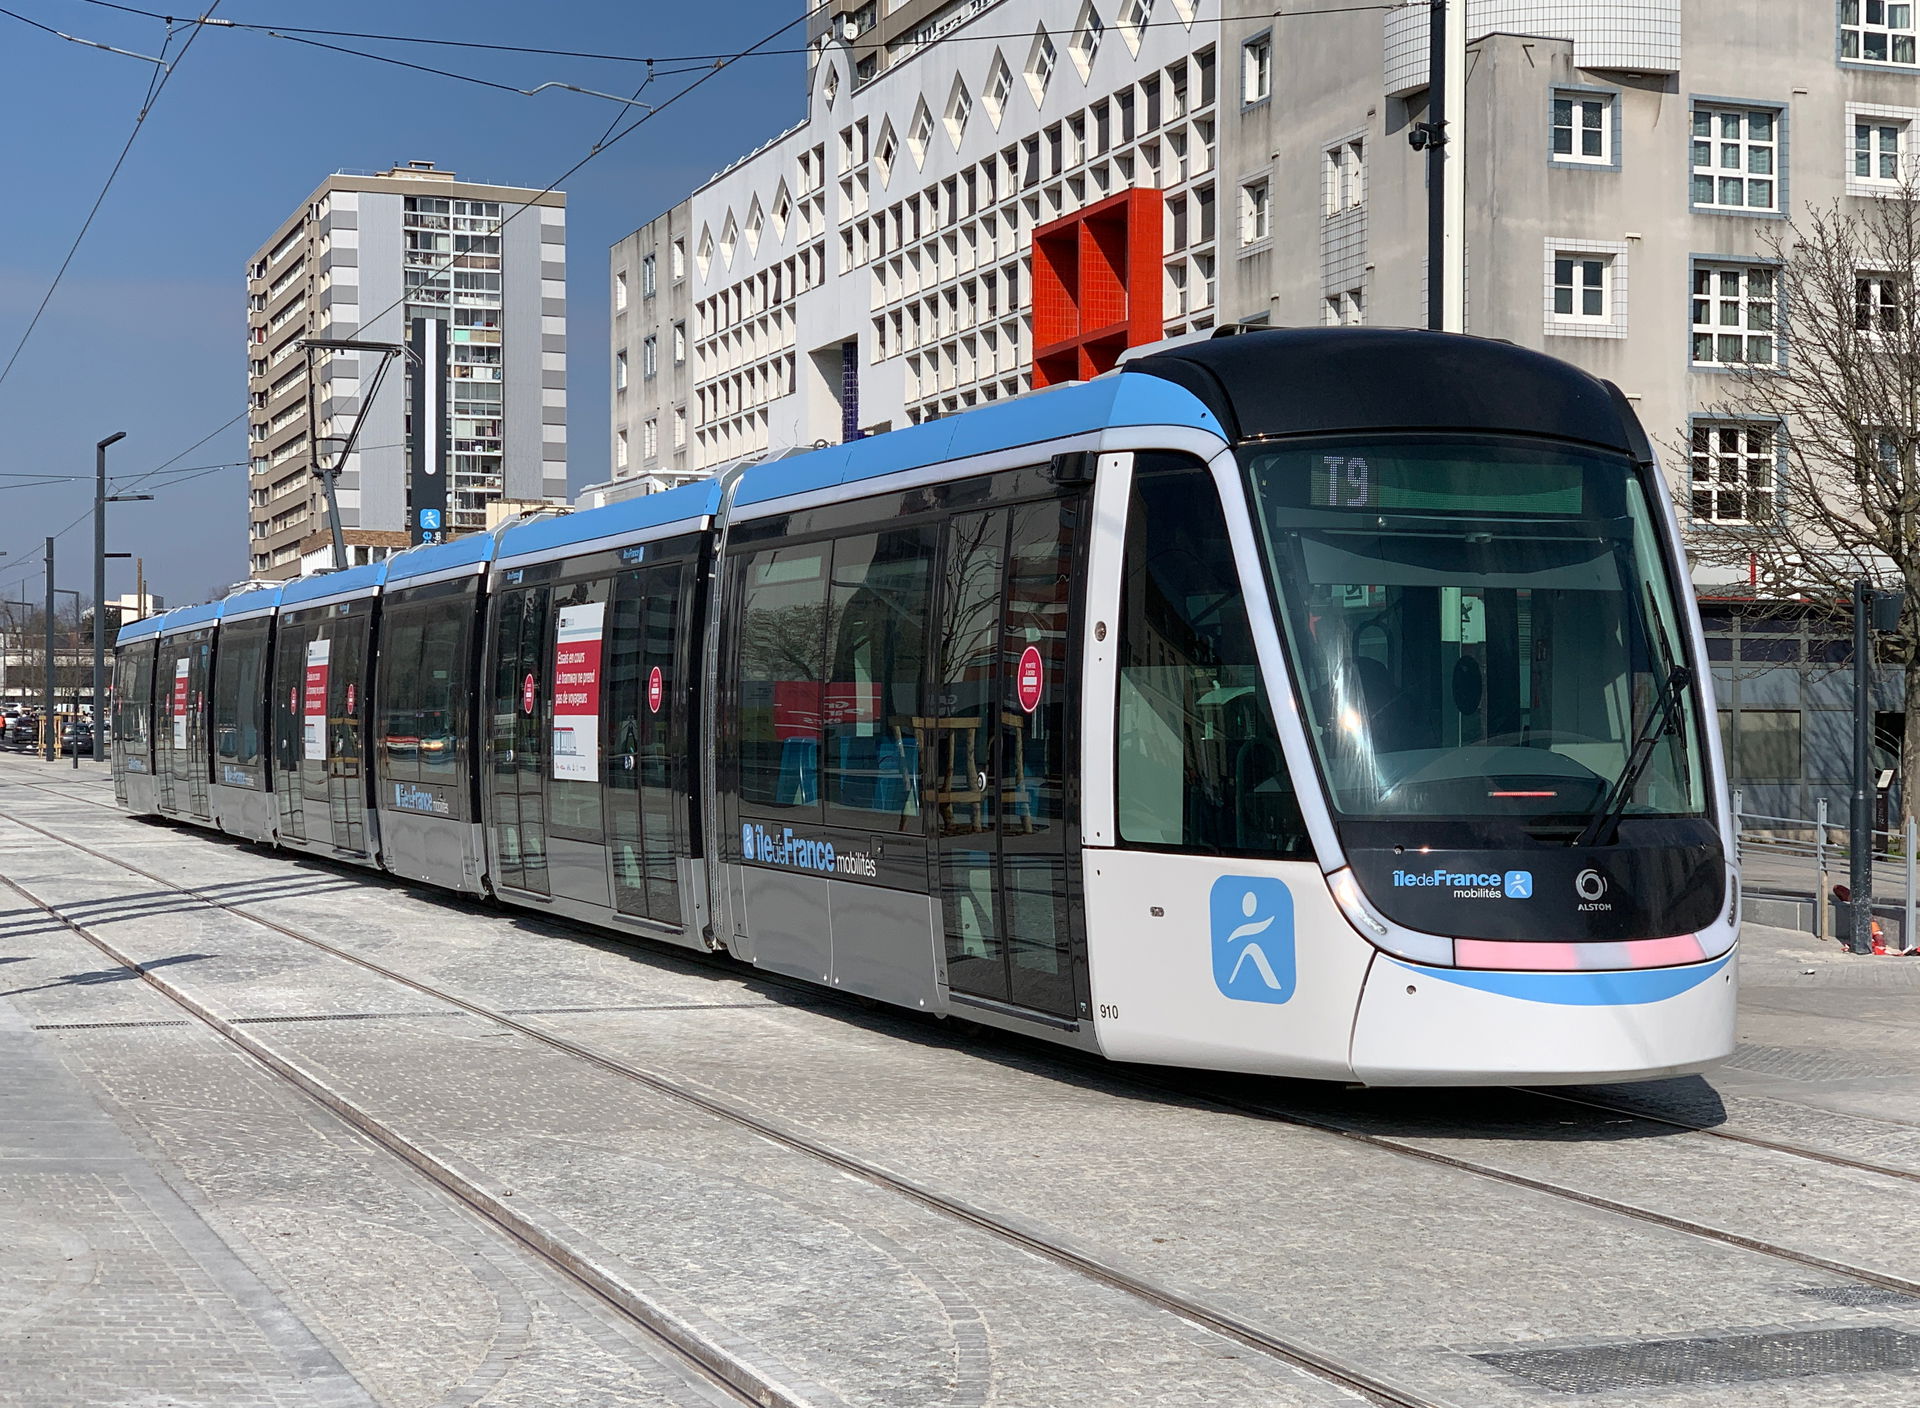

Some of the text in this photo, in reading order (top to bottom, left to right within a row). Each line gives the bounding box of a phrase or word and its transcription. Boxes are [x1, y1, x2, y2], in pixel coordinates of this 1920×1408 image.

[1323, 456, 1368, 506] T9
[836, 851, 877, 877] mobilités
[1453, 887, 1501, 899] mobilités
[1577, 903, 1612, 911] ALSTOM
[1099, 1004, 1119, 1019] 910
